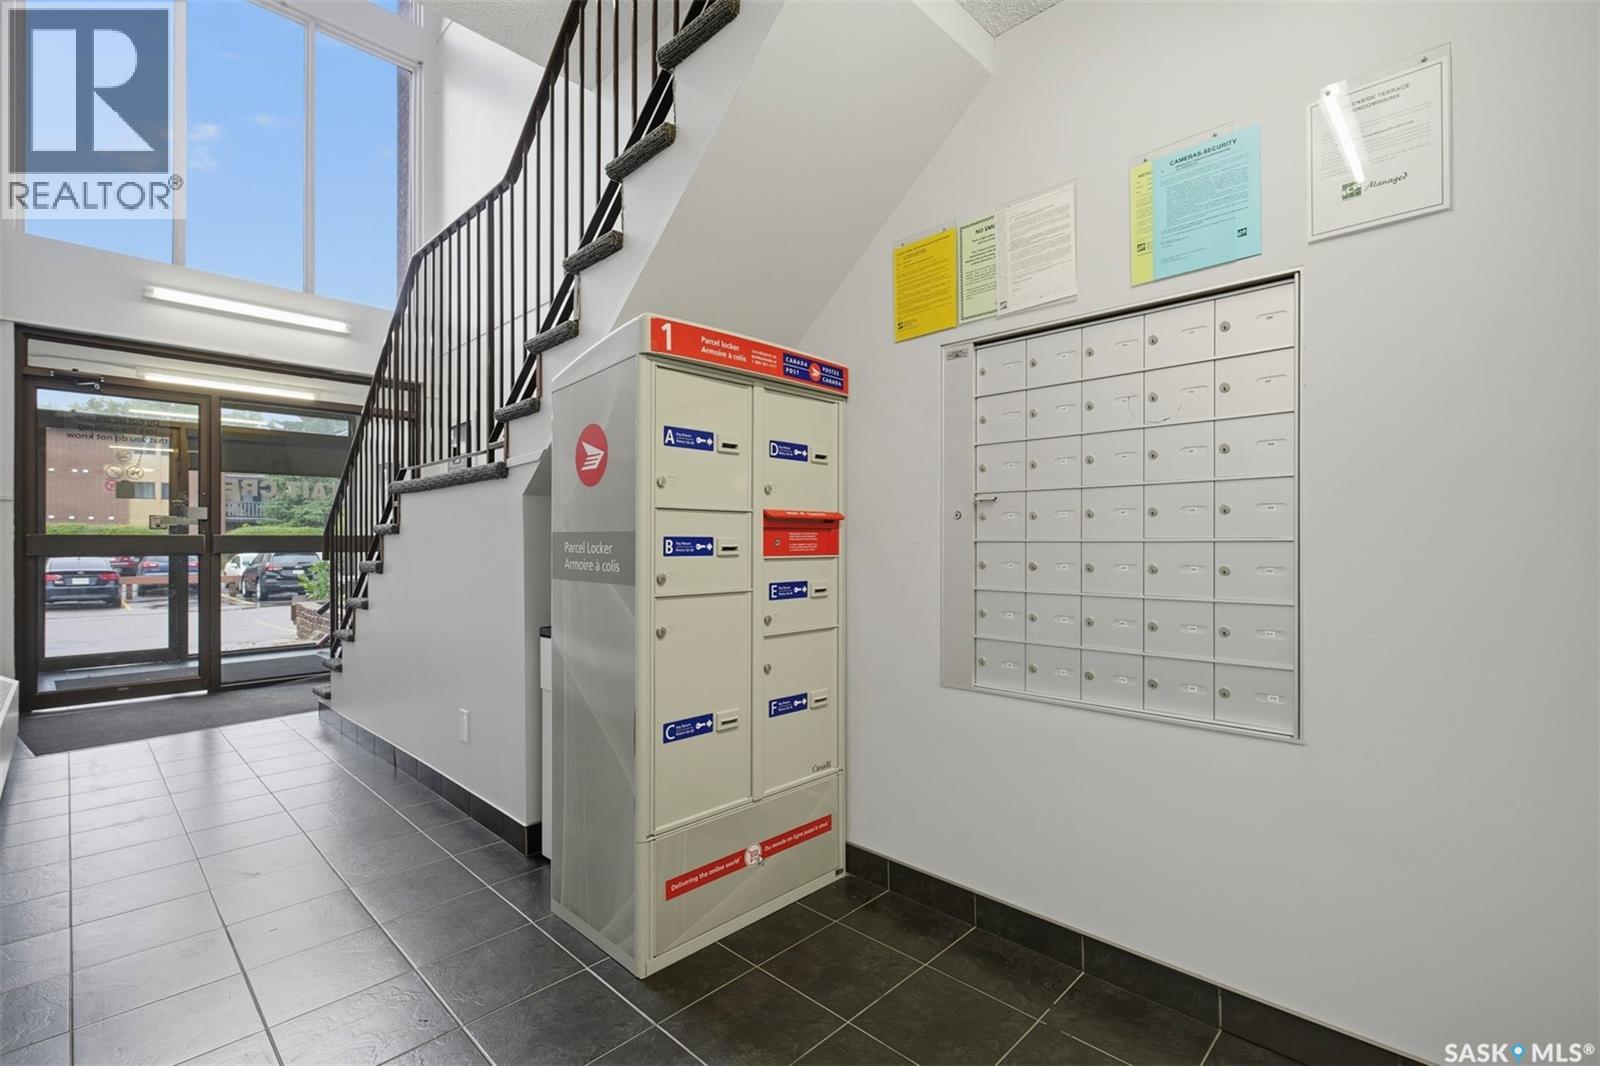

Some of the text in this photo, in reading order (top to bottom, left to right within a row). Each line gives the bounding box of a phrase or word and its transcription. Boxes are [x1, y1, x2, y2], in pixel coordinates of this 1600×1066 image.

[1351, 93, 1401, 113] ONDOMINIUMS
[1365, 171, 1408, 192] Managed
[661, 322, 672, 351] 1
[701, 335, 720, 346] Parcel
[701, 346, 727, 358] Armoire
[785, 356, 808, 367] CANADA
[785, 367, 800, 376] POST
[822, 376, 842, 387] CANADA
[664, 429, 675, 445] A
[770, 442, 779, 456] D
[564, 540, 613, 555] Parcel Locker
[665, 539, 674, 554] B
[564, 558, 594, 571] Armoire
[601, 559, 620, 573] colis
[771, 584, 778, 599] E
[771, 701, 778, 715] F
[665, 724, 676, 740] C
[671, 876, 699, 892] Delivering
[699, 872, 709, 880] the
[708, 864, 725, 876] online
